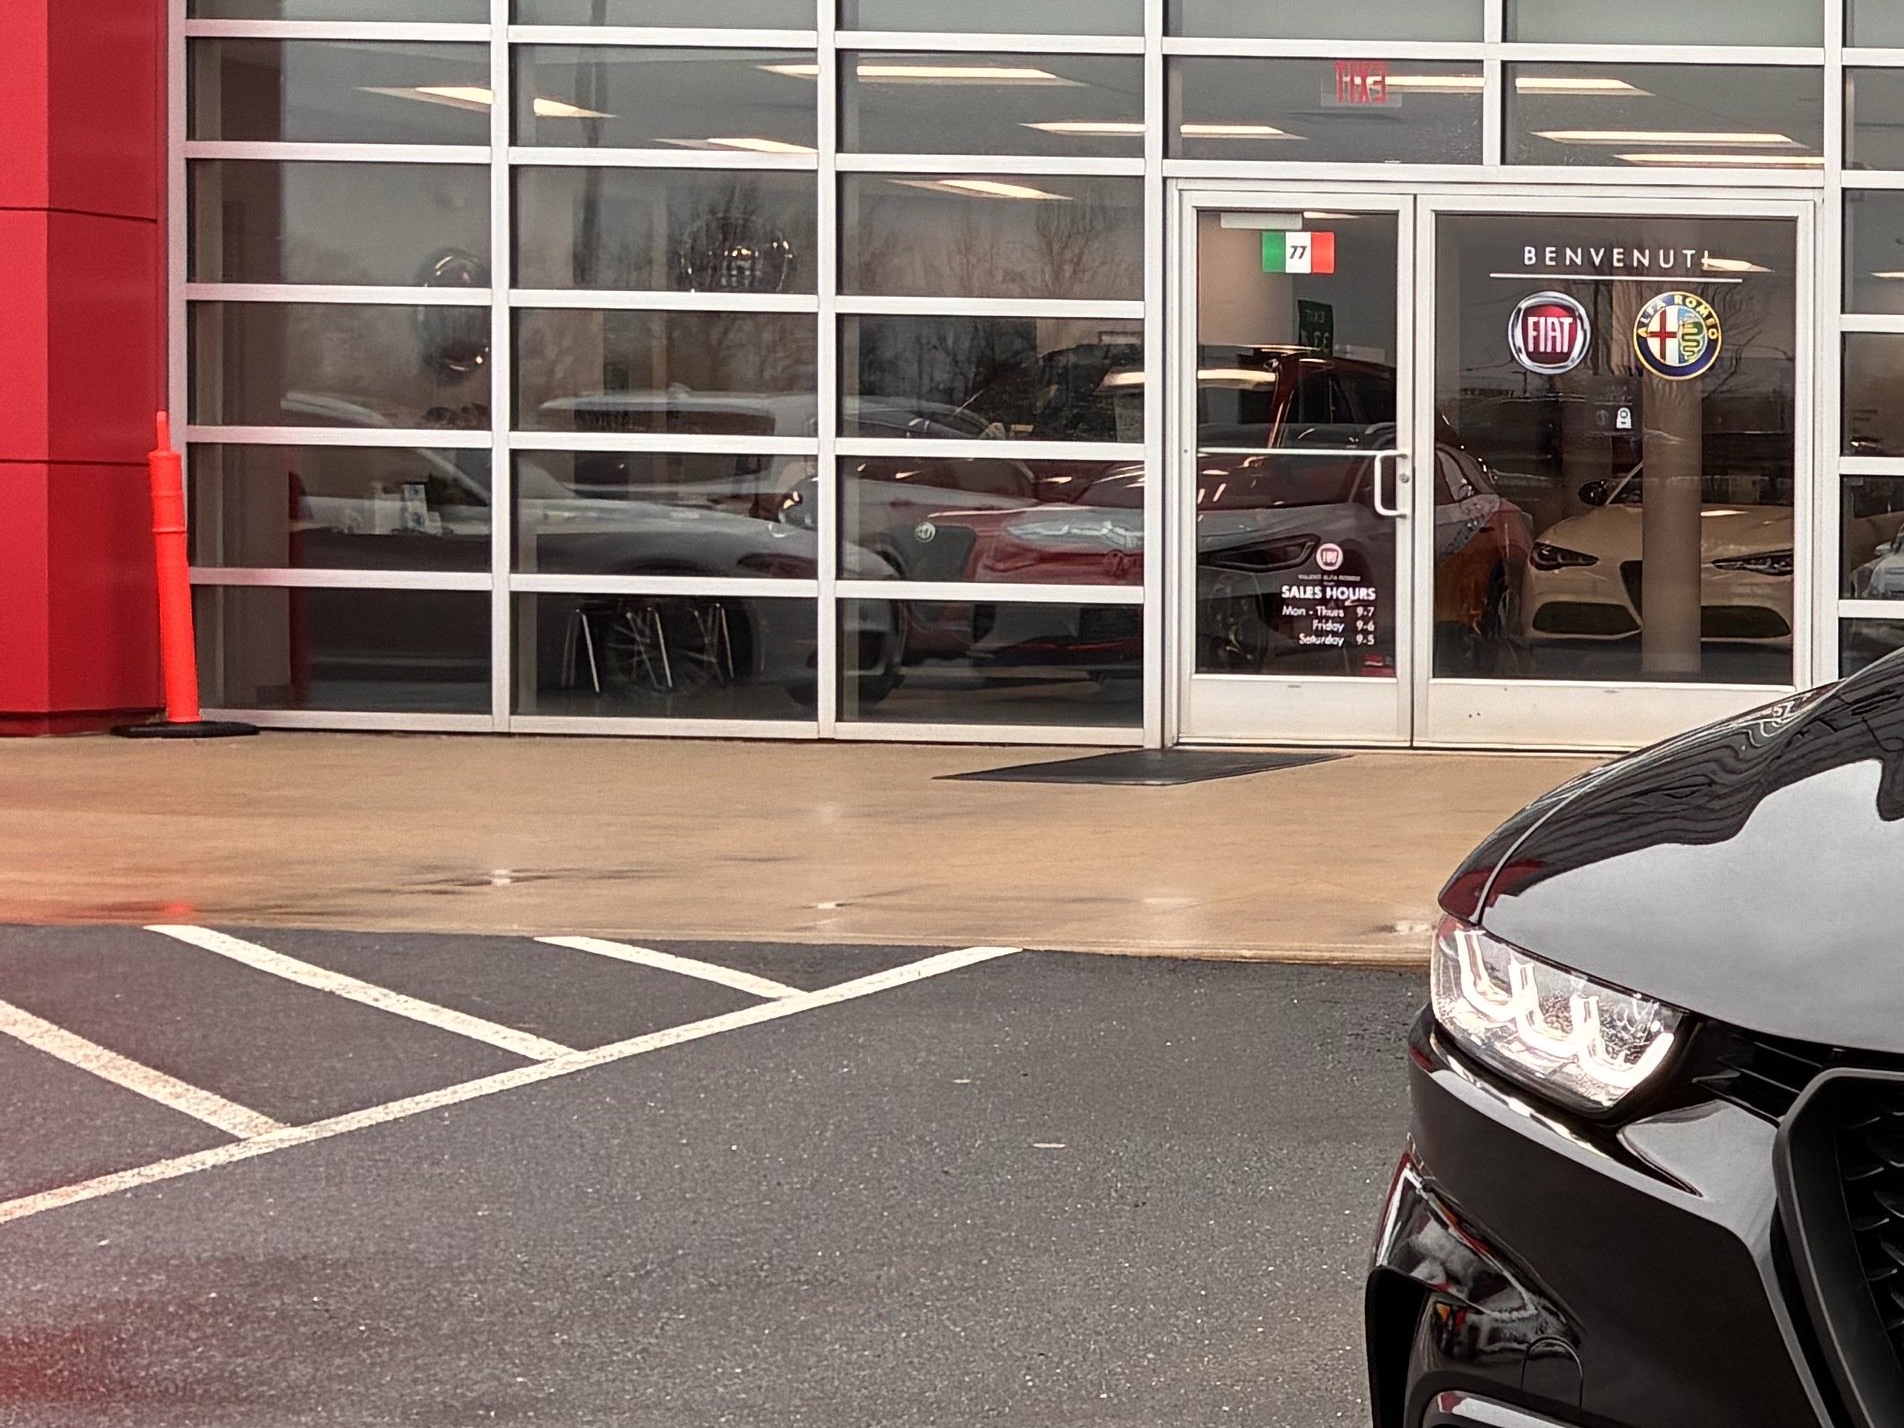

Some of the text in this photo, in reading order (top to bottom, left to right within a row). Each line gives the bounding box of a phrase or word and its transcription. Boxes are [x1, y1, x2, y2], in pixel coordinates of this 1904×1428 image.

[1636, 294, 1719, 341] ALFA ROMEO
[1526, 316, 1575, 354] FIAT
[1281, 585, 1376, 600] SALES HOURS
[1281, 605, 1306, 616] Mon
[1356, 606, 1375, 617] 9-7
[1312, 619, 1375, 633] Friday 9-6
[1298, 633, 1375, 647] Saturday 9-5
